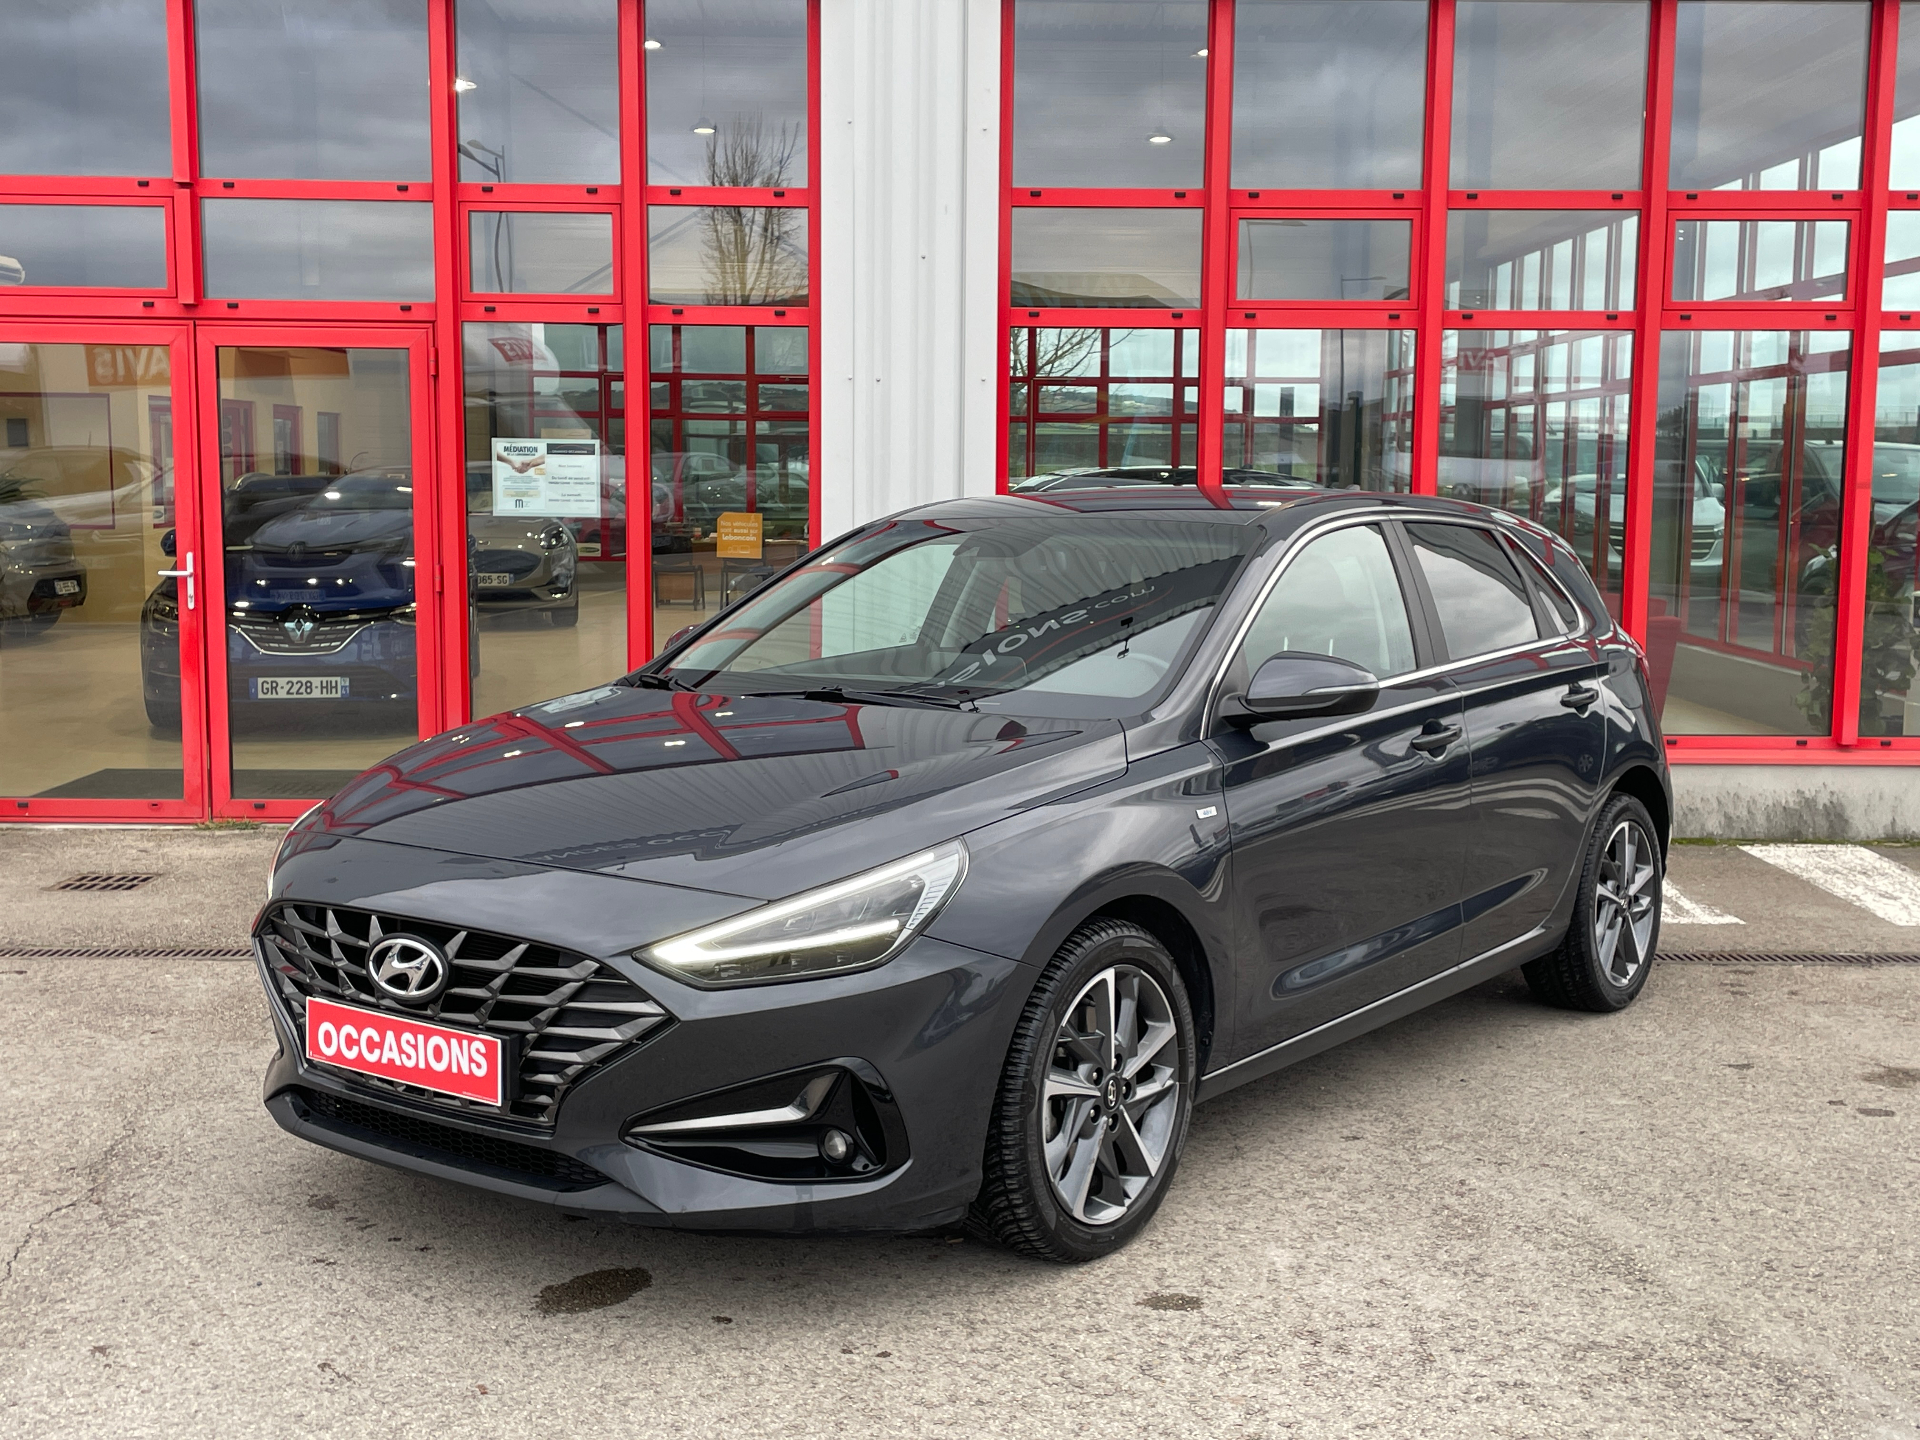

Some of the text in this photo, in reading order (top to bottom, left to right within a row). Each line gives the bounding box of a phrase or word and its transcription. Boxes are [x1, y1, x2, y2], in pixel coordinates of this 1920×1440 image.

[503, 444, 538, 454] MÉDIATION
[260, 680, 339, 696] GR-228-HH
[317, 1021, 488, 1078] OCCASIONS
